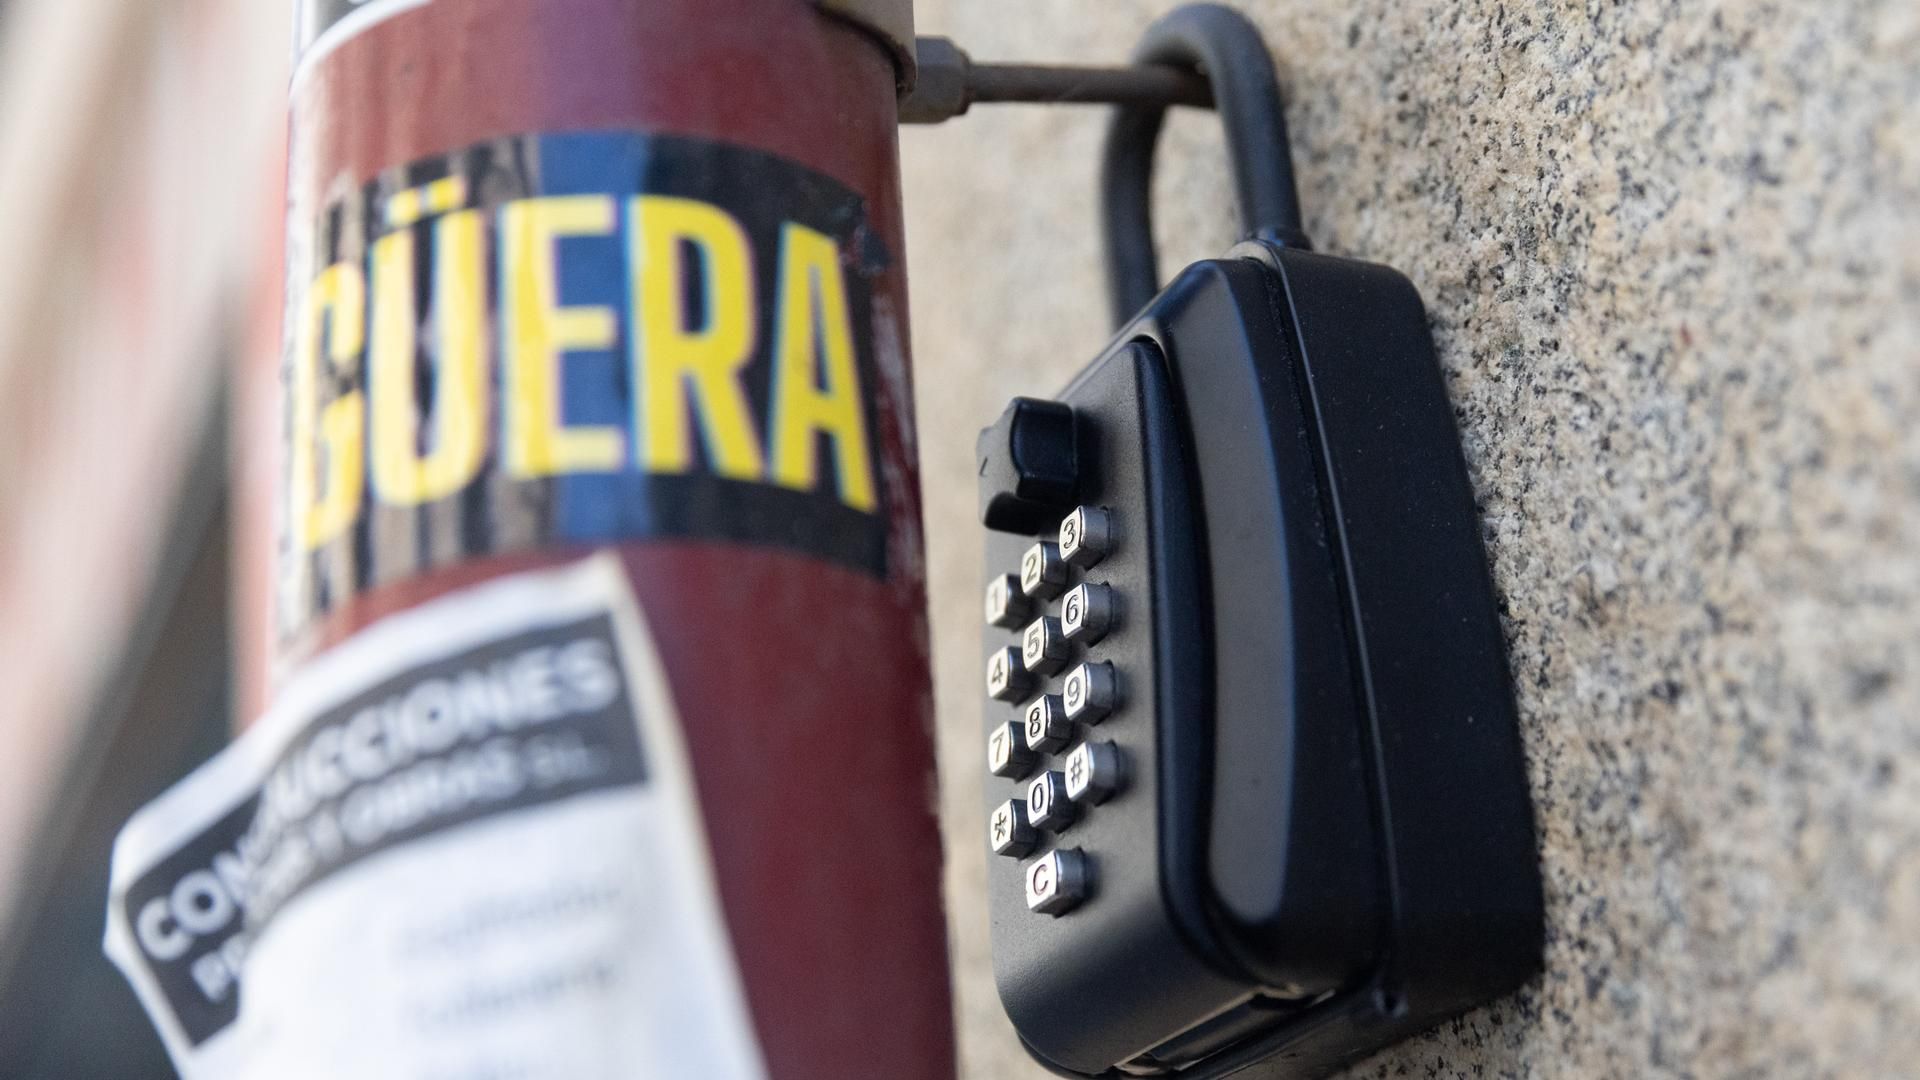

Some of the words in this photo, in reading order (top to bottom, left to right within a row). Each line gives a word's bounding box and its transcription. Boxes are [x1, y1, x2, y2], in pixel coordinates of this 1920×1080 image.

[1025, 556, 1037, 582] 2
[1063, 518, 1076, 549] 3
[991, 658, 1004, 684] 4
[1026, 627, 1040, 658] 5
[1065, 594, 1079, 626] 6
[992, 732, 1004, 764] 7
[1029, 706, 1041, 737] 8
[1067, 675, 1080, 706] 9
[136, 636, 620, 960] CONUCCIONES
[1032, 782, 1044, 814] 0
[1070, 752, 1083, 788] #
[1032, 863, 1048, 896] C
